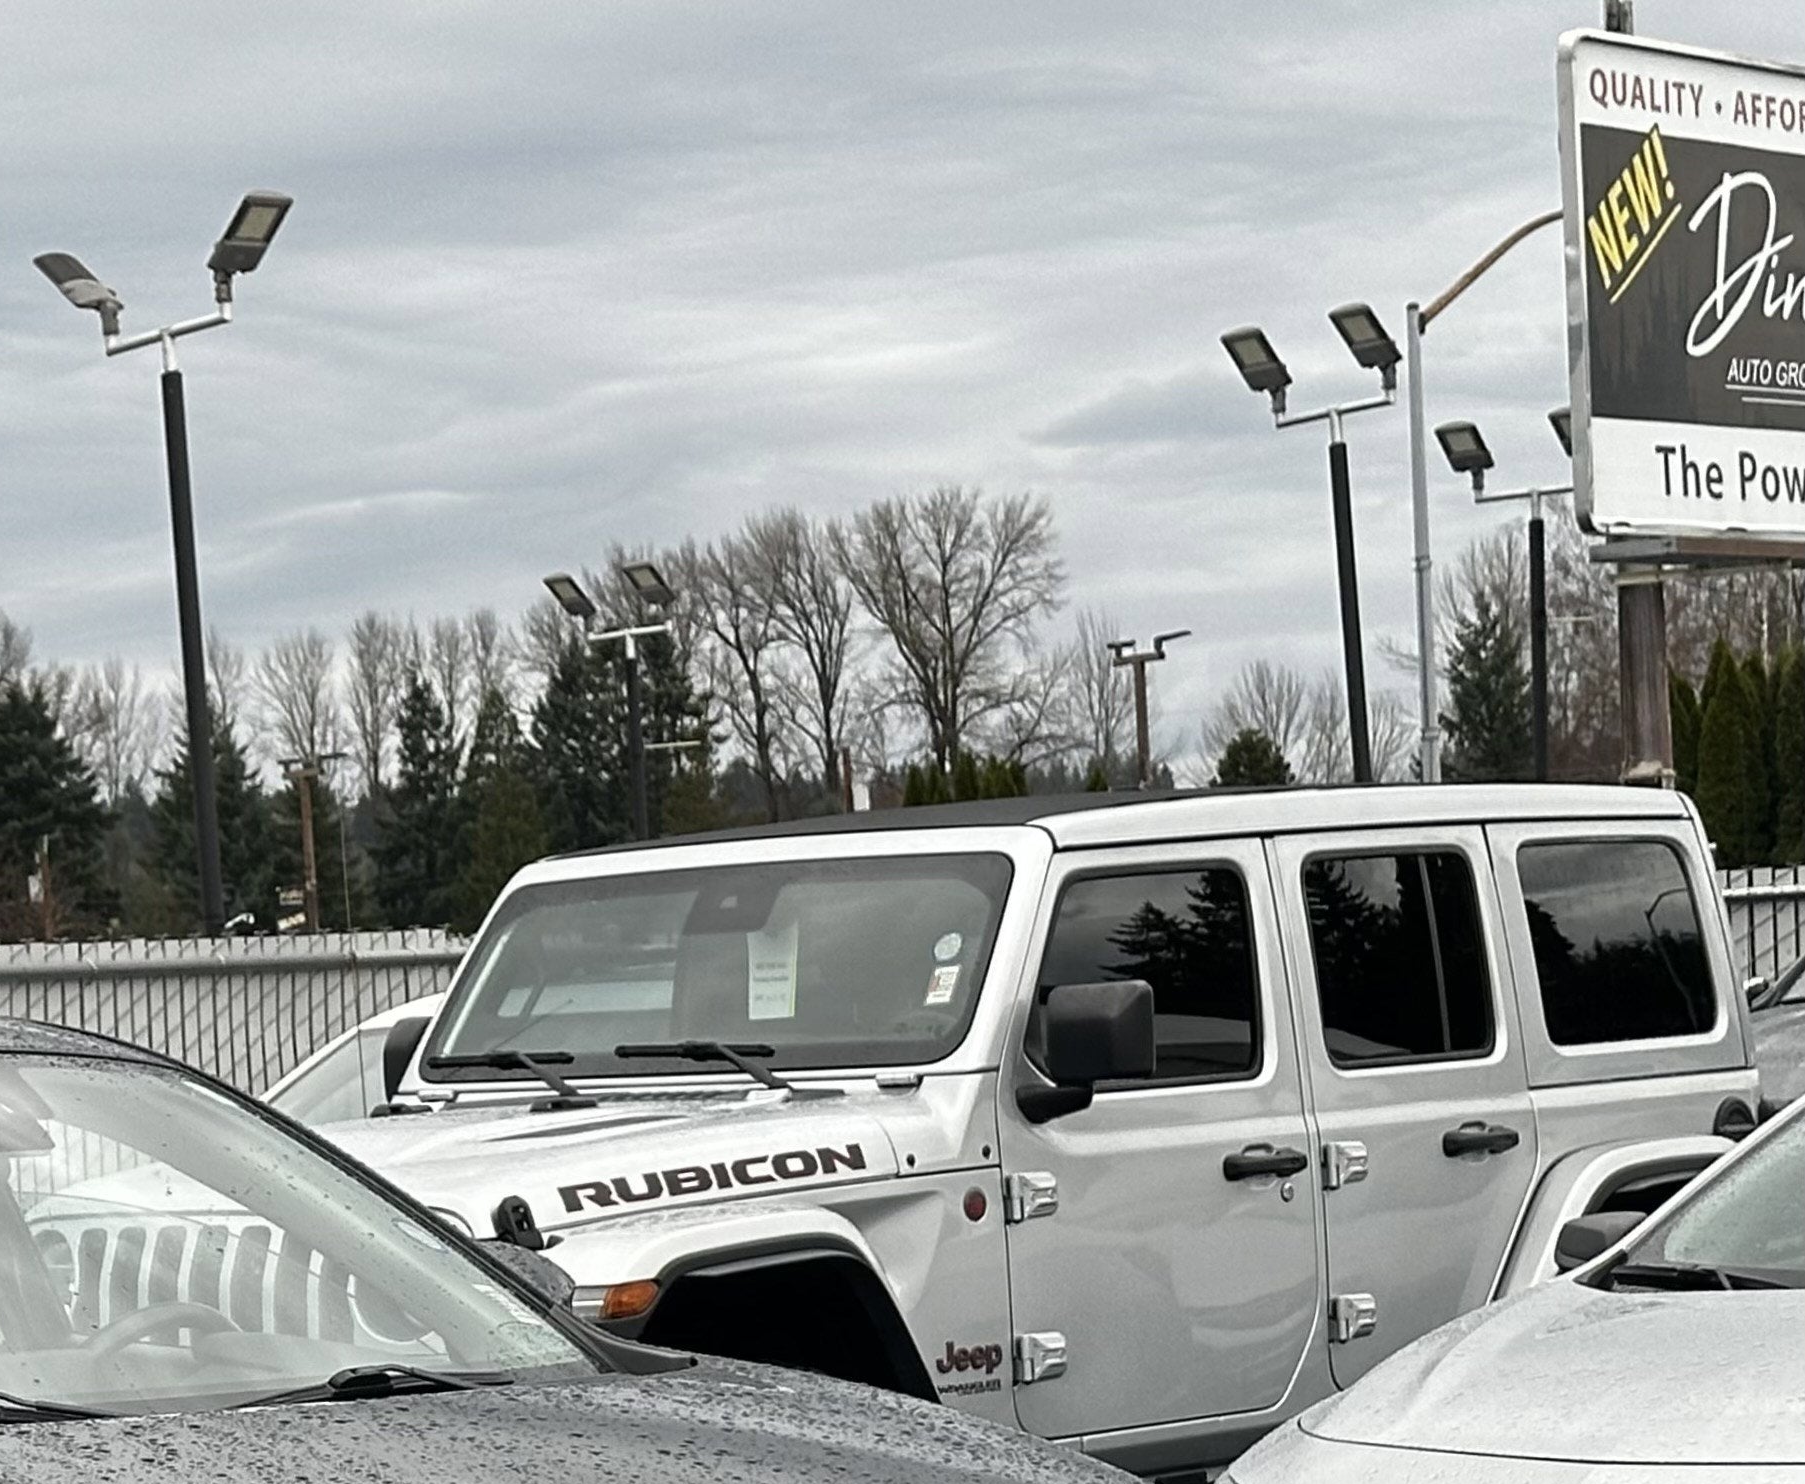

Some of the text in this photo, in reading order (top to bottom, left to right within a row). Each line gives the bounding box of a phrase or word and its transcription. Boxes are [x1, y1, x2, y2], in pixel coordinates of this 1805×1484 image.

[1589, 68, 1703, 118] QUALITY
[1587, 128, 1676, 289] NEW!
[1727, 357, 1772, 385] AUTO
[1655, 445, 1724, 500] The
[557, 1143, 867, 1213] RUBICON
[936, 1341, 1003, 1375] Jeep
